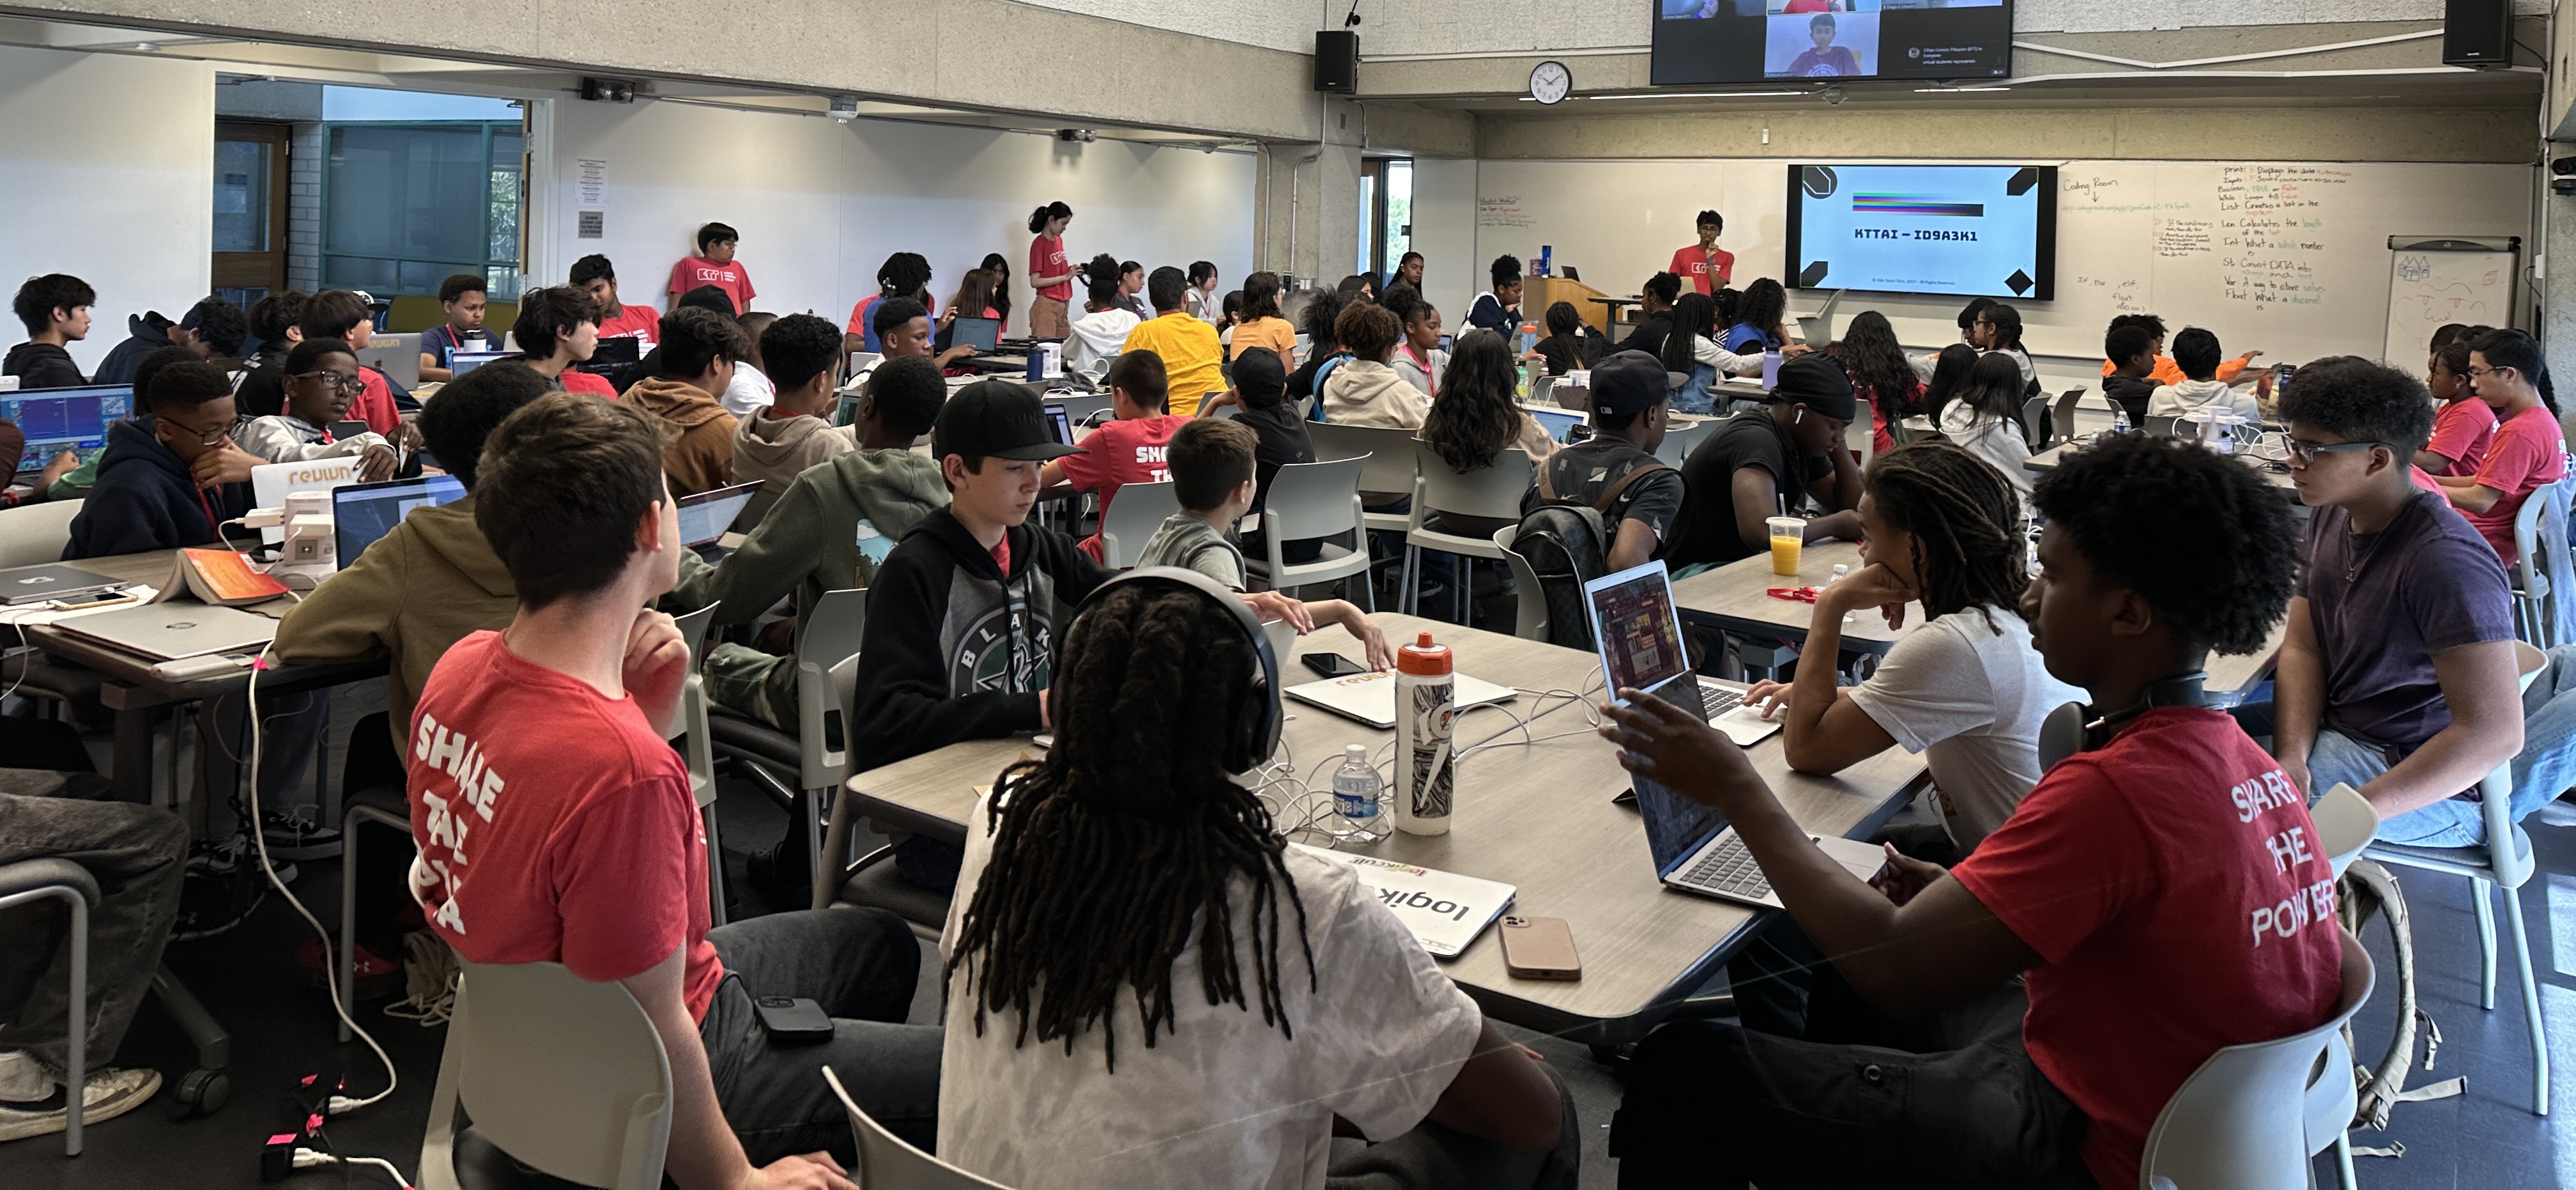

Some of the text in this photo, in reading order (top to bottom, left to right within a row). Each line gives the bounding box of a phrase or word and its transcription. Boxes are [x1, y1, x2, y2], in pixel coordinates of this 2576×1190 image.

[2063, 177, 2119, 195] Coding Room
[2281, 183, 2298, 192] False
[2221, 201, 2240, 211] List
[2244, 200, 2274, 210] Creates
[2221, 219, 2235, 228] Len
[2239, 218, 2280, 228] Calculates
[2285, 218, 2298, 227] the
[1854, 228, 1899, 240] KTTAI
[1914, 229, 1979, 242] ID9A3K1
[2223, 237, 2240, 246] Int
[2244, 237, 2267, 248] What
[2300, 241, 2325, 250] number
[2240, 258, 2268, 268] Convert
[2269, 259, 2295, 270] DATA
[2224, 275, 2236, 286] Var
[2243, 277, 2249, 287] A
[2253, 282, 2266, 292] way
[2269, 281, 2277, 289] to
[2280, 282, 2299, 291] store
[2112, 293, 2133, 302] float
[2225, 288, 2248, 300] Float
[2255, 291, 2278, 303] What
[2291, 294, 2322, 304] decimal
[961, 613, 1052, 670] BLAK
[2231, 769, 2297, 824] SHARE
[2266, 826, 2313, 876] THE
[2251, 878, 2336, 948] POWER
